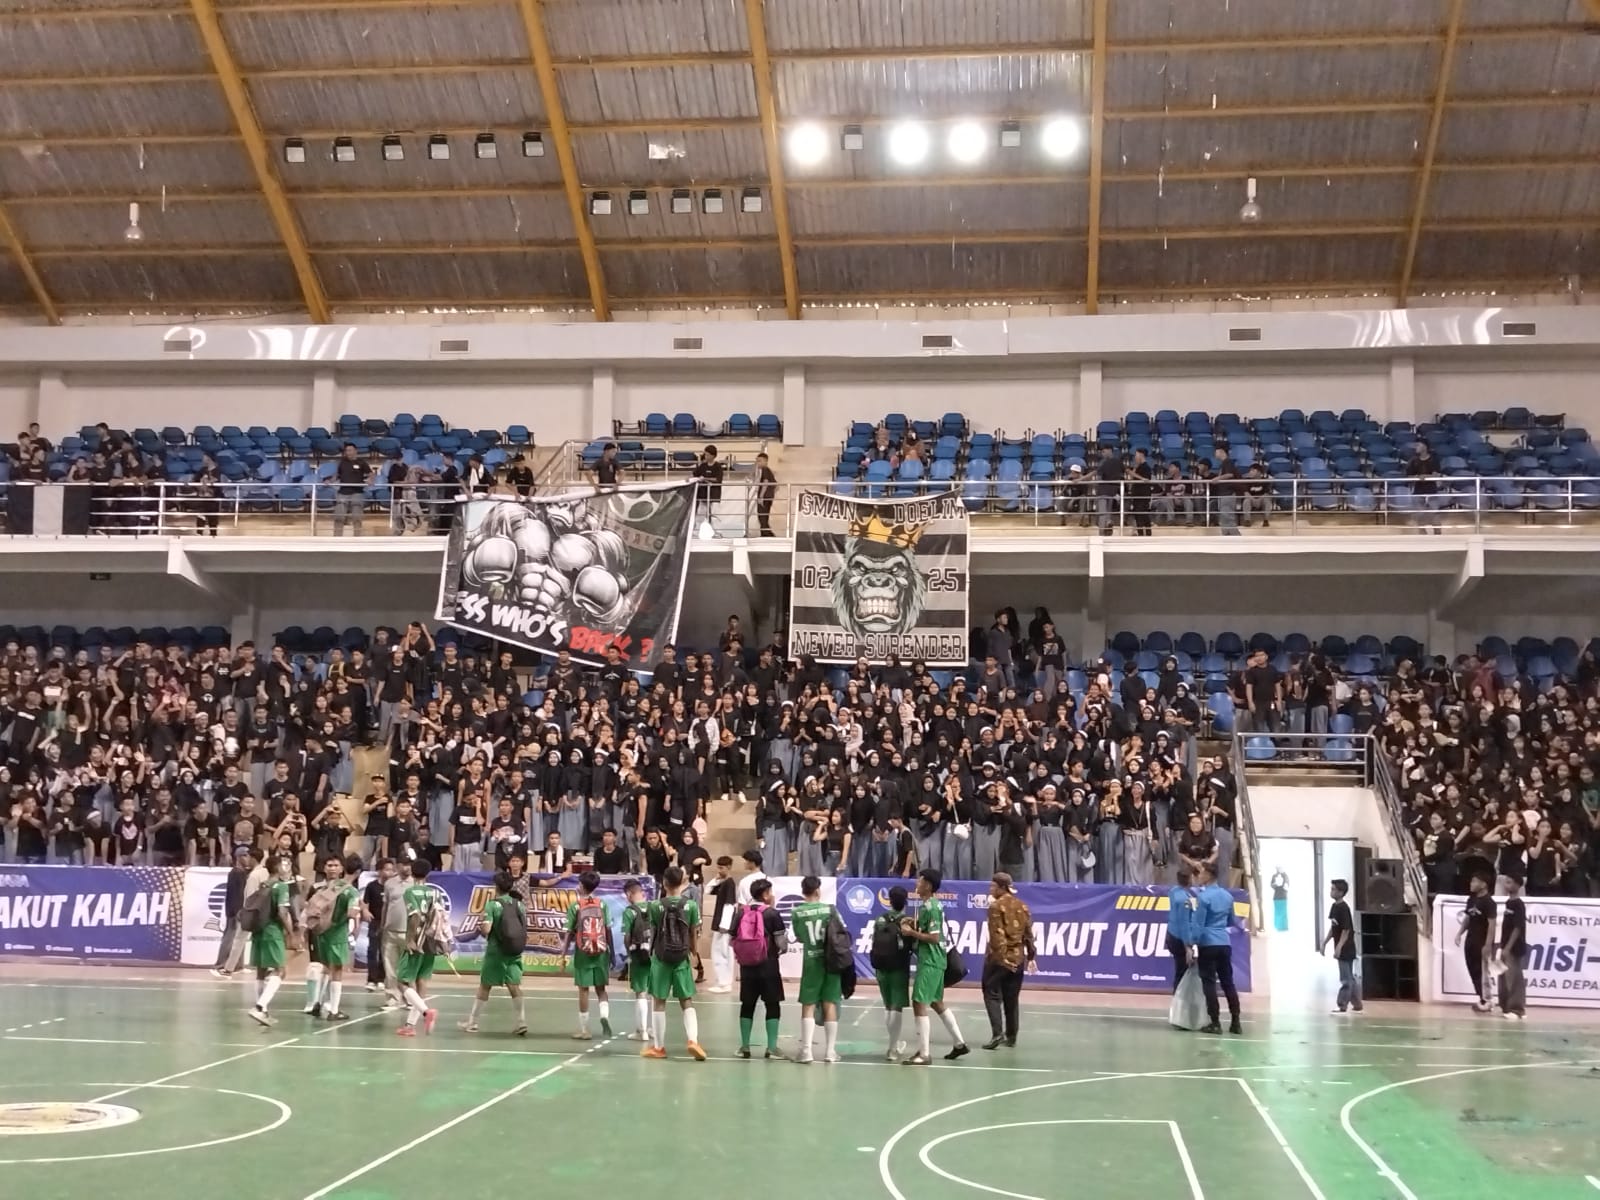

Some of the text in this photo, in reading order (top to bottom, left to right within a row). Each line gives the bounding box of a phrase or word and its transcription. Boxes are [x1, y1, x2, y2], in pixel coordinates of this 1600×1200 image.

[802, 493, 857, 521] SMAN
[802, 565, 958, 592] 02 25
[491, 604, 568, 646] WHO'S
[793, 631, 964, 659] NEVER SURENDER
[72, 892, 171, 928] KALAH
